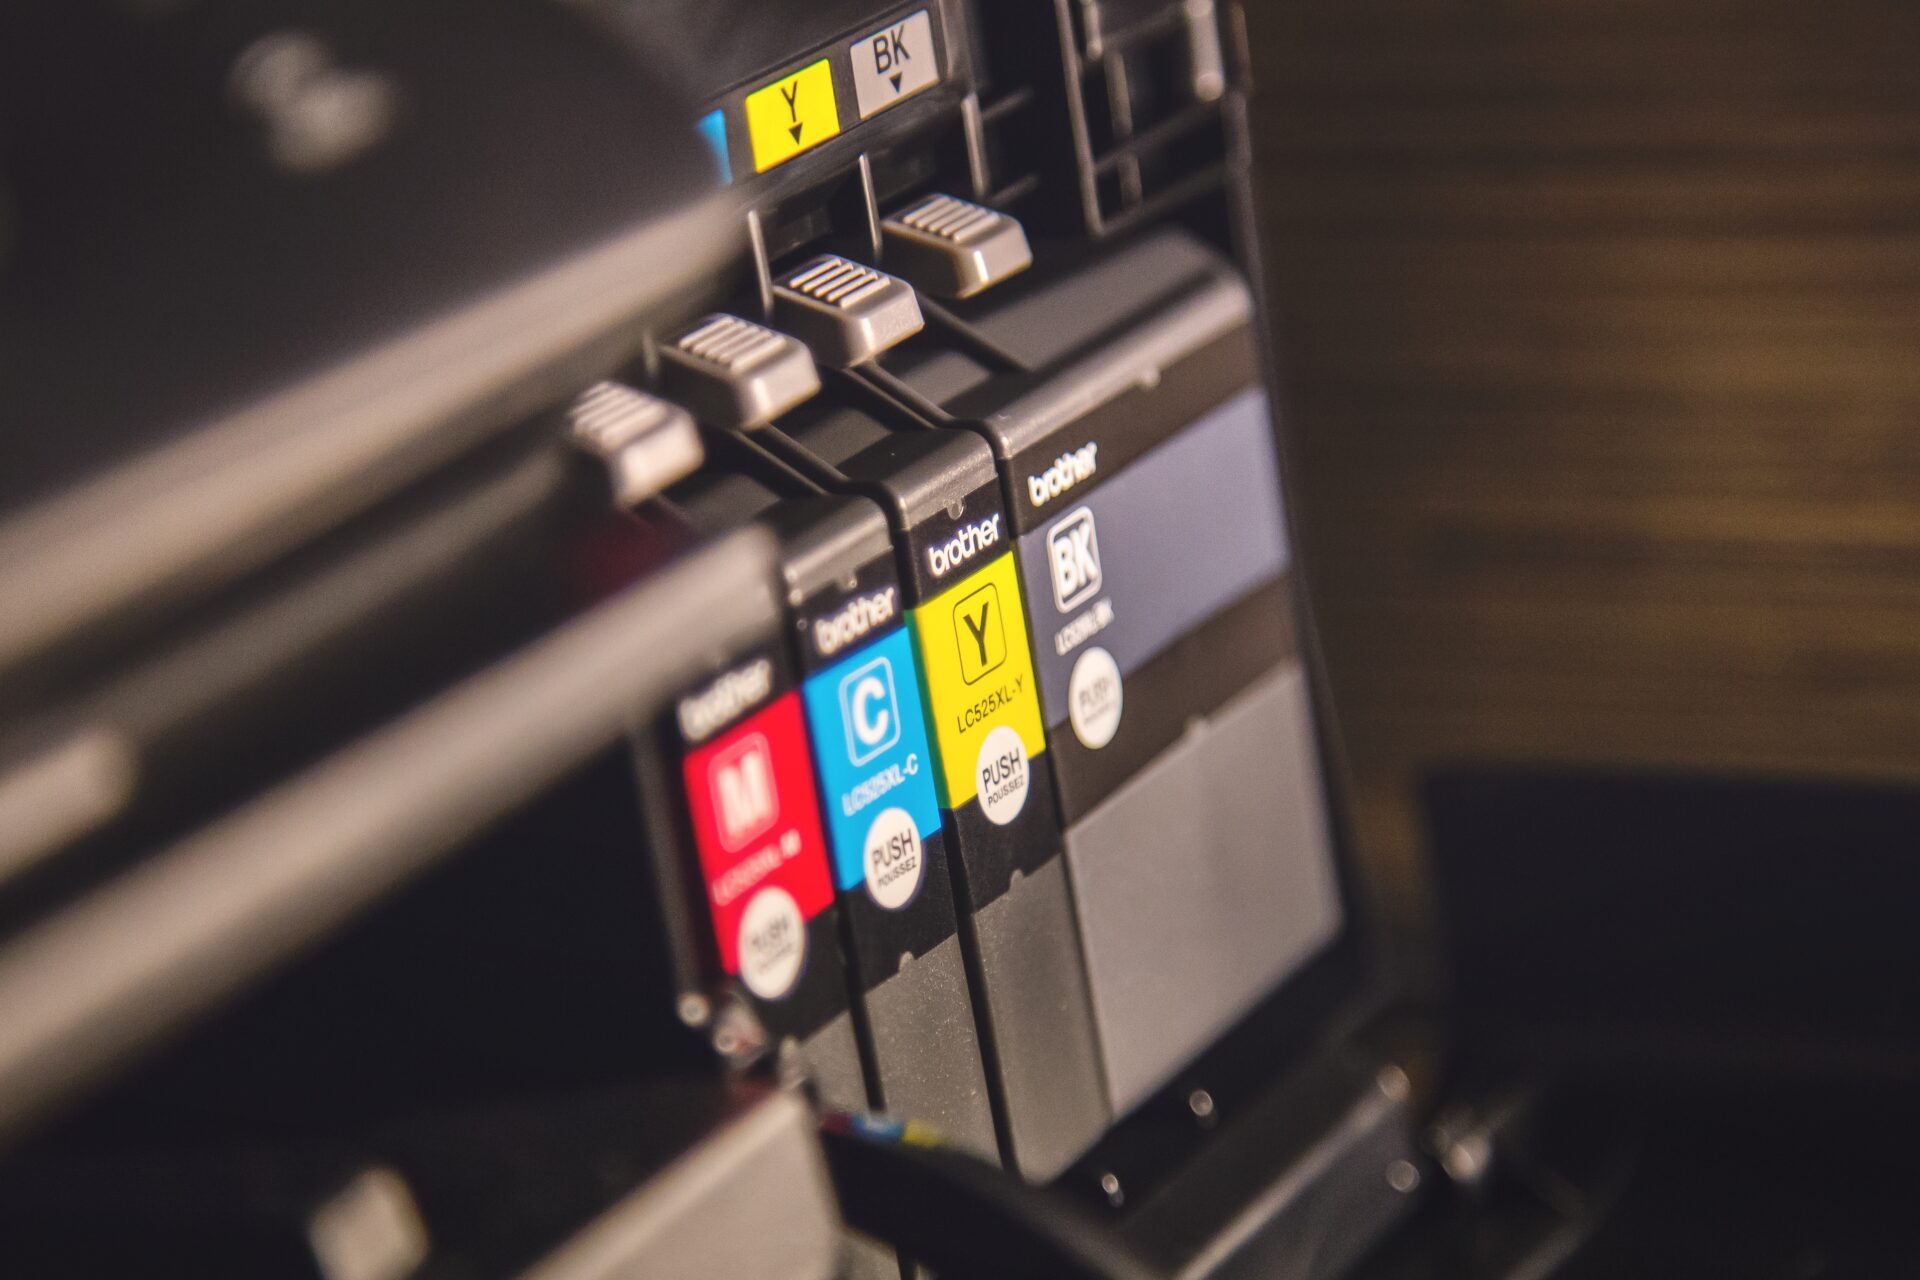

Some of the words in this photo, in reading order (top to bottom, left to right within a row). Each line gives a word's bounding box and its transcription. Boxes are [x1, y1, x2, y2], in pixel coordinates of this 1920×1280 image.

[872, 23, 911, 75] BK
[781, 80, 798, 123] Y
[1027, 441, 1098, 507] brother
[928, 512, 1000, 577] brother
[1054, 520, 1099, 598] BK
[814, 586, 895, 655] brother
[963, 600, 989, 668] Y
[852, 676, 889, 746] C
[956, 673, 1024, 734] LC525XL-Y
[716, 749, 773, 836] M
[982, 747, 1022, 794] PUSH
[987, 774, 1025, 809] POUSSEZ
[872, 827, 915, 875] PUSH
